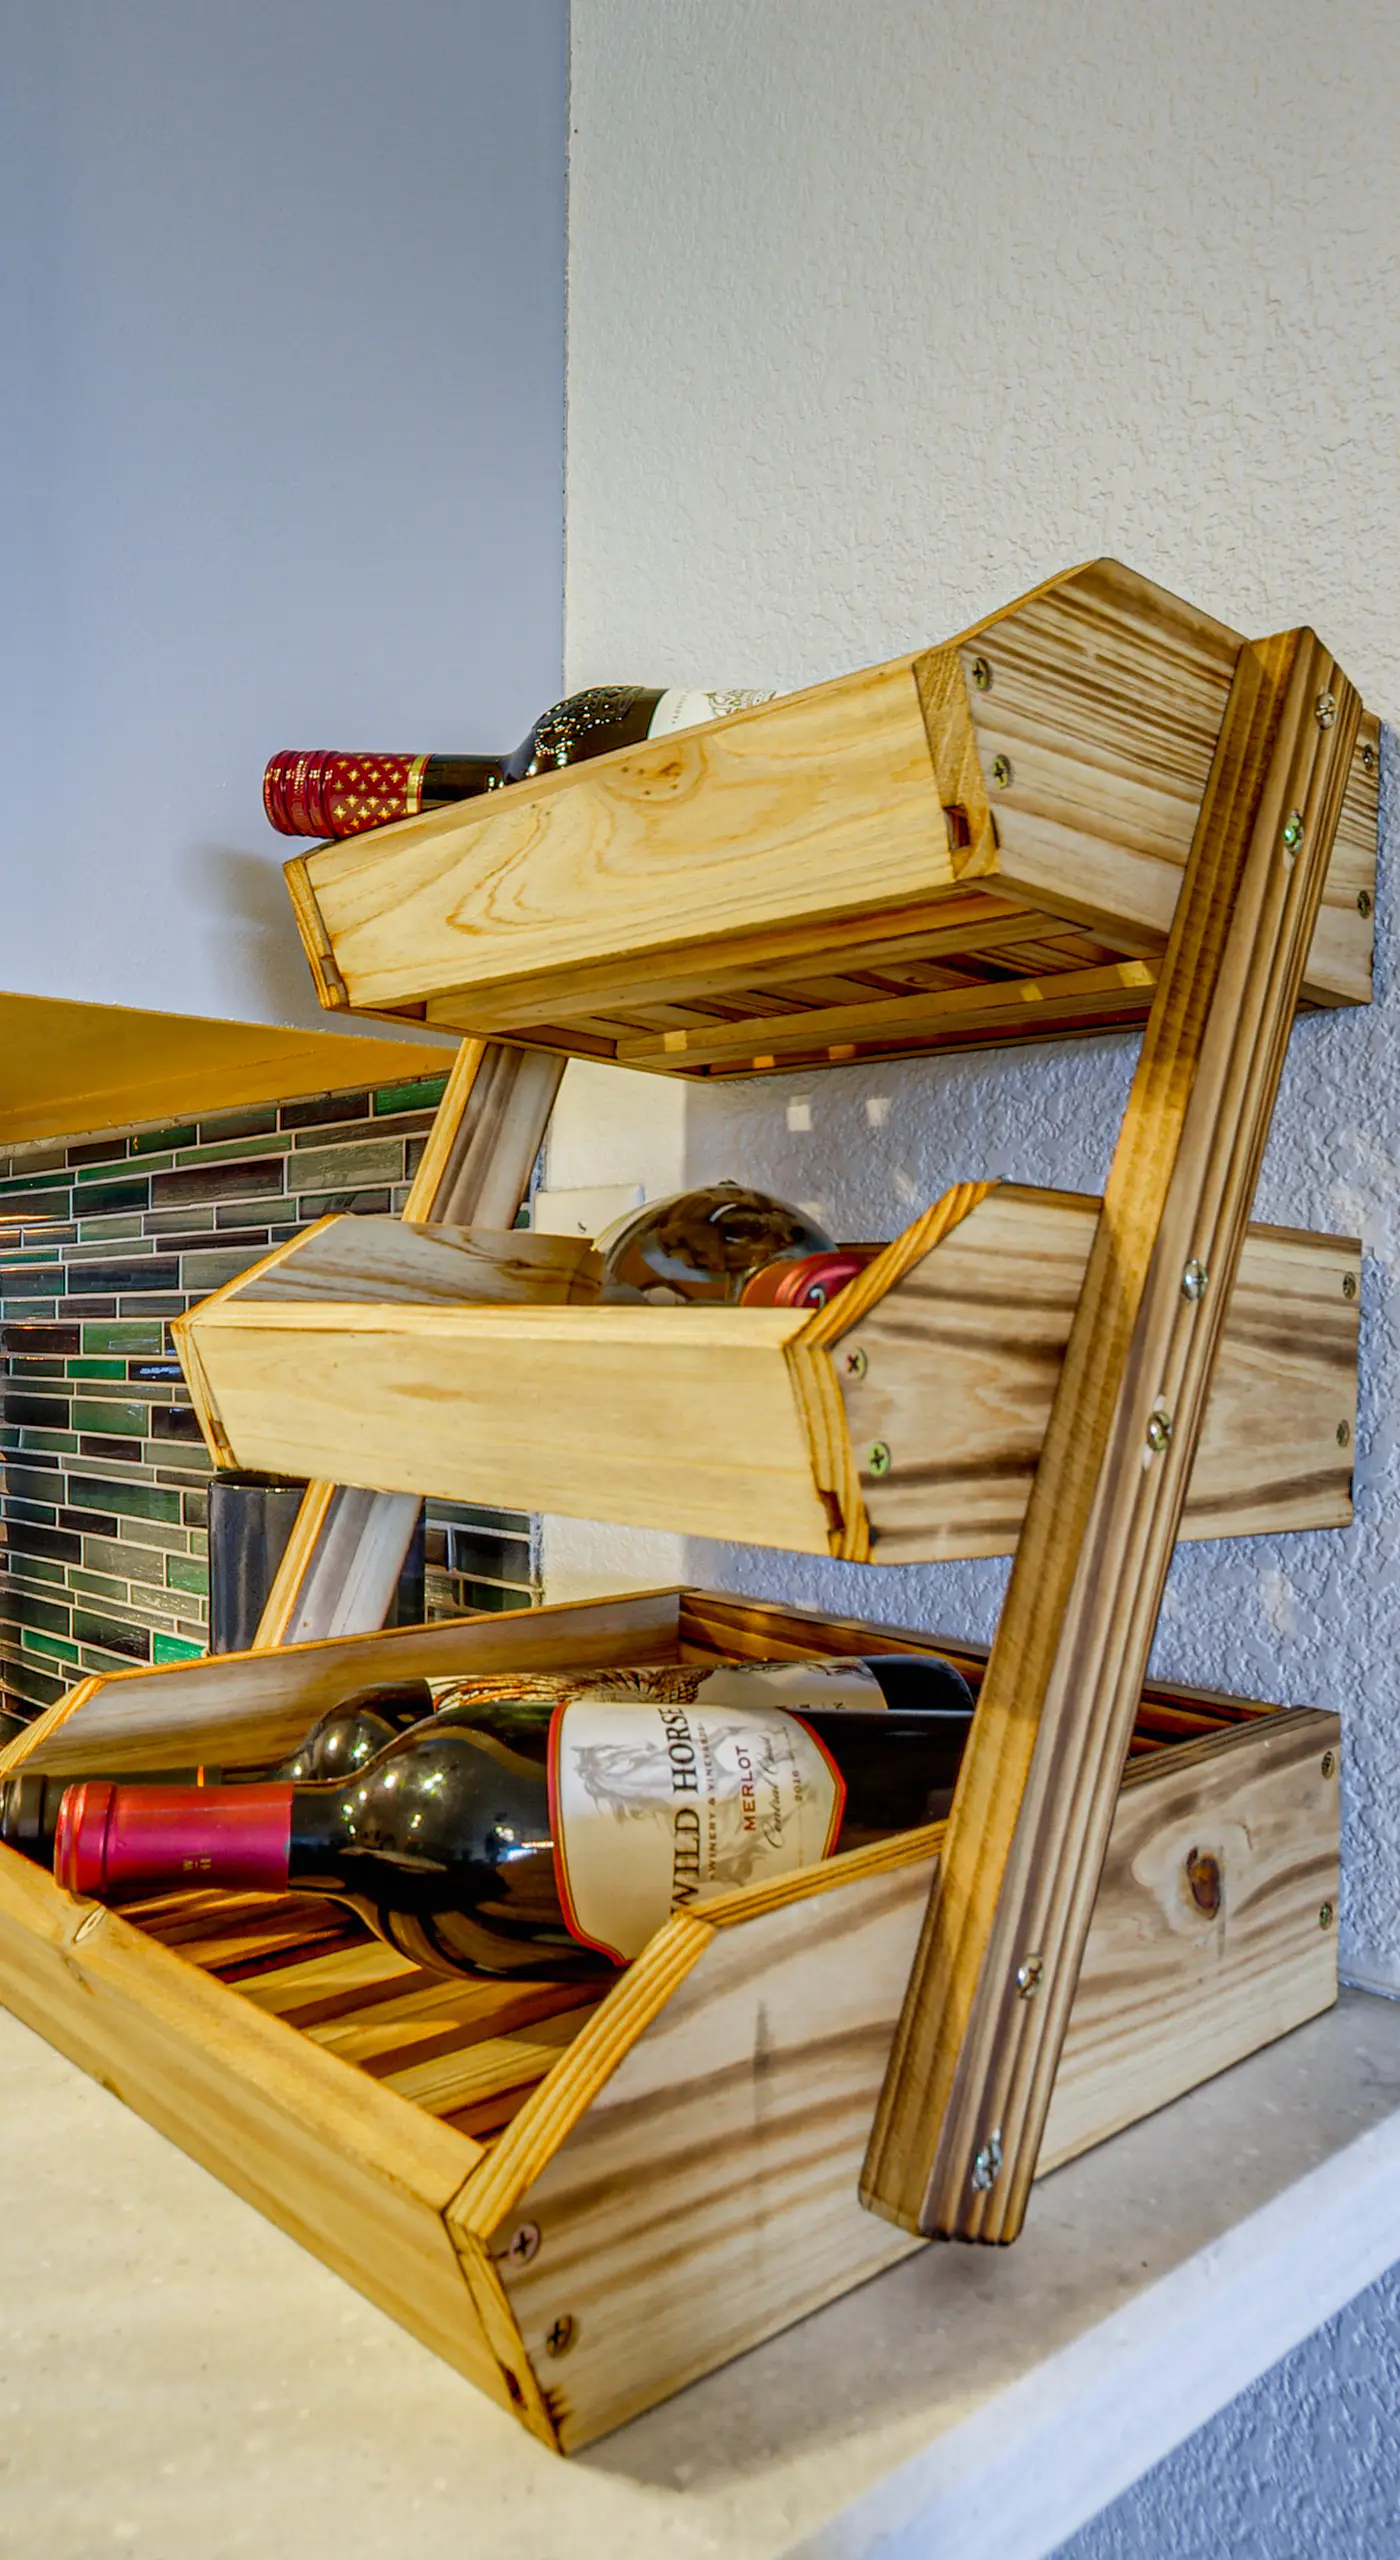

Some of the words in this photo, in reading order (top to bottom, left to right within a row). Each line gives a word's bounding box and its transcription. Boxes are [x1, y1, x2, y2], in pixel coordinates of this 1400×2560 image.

[657, 1708, 697, 1794] HORSE
[735, 1745, 757, 1832] MERLOT
[792, 1769, 804, 1802] 2016
[707, 1798, 716, 1806] &
[758, 1771, 785, 1849] Central
[671, 1808, 700, 1914] WILD
[708, 1813, 717, 1872] WINERY
